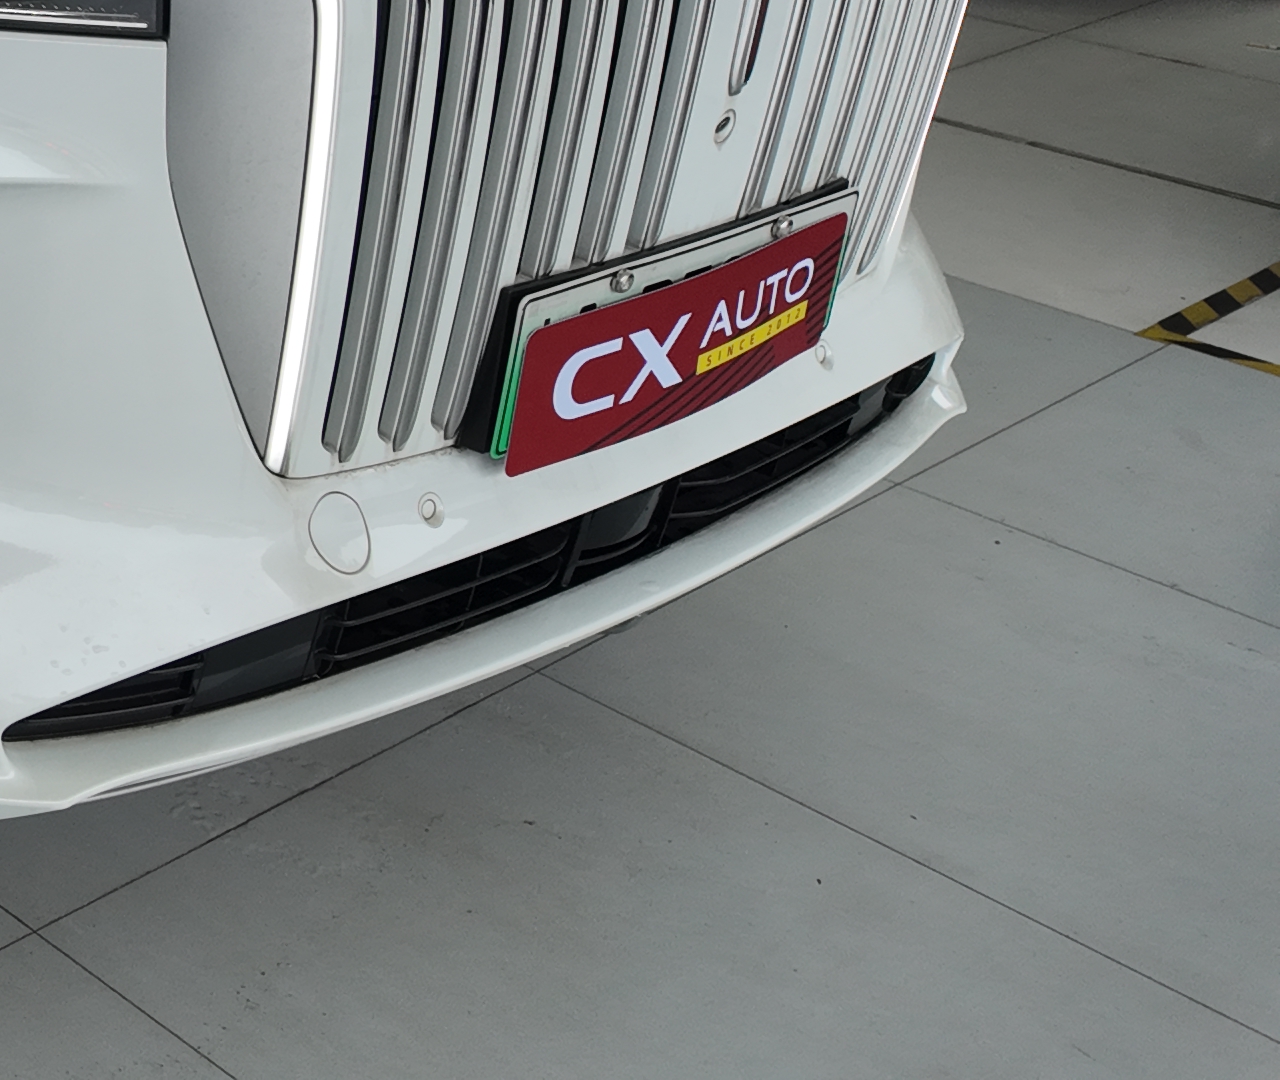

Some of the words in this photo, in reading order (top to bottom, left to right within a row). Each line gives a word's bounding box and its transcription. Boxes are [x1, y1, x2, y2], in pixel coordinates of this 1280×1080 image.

[552, 312, 692, 420] CX
[699, 257, 815, 348] AUTO
[706, 333, 757, 368] SINCE
[766, 306, 803, 336] 2012
